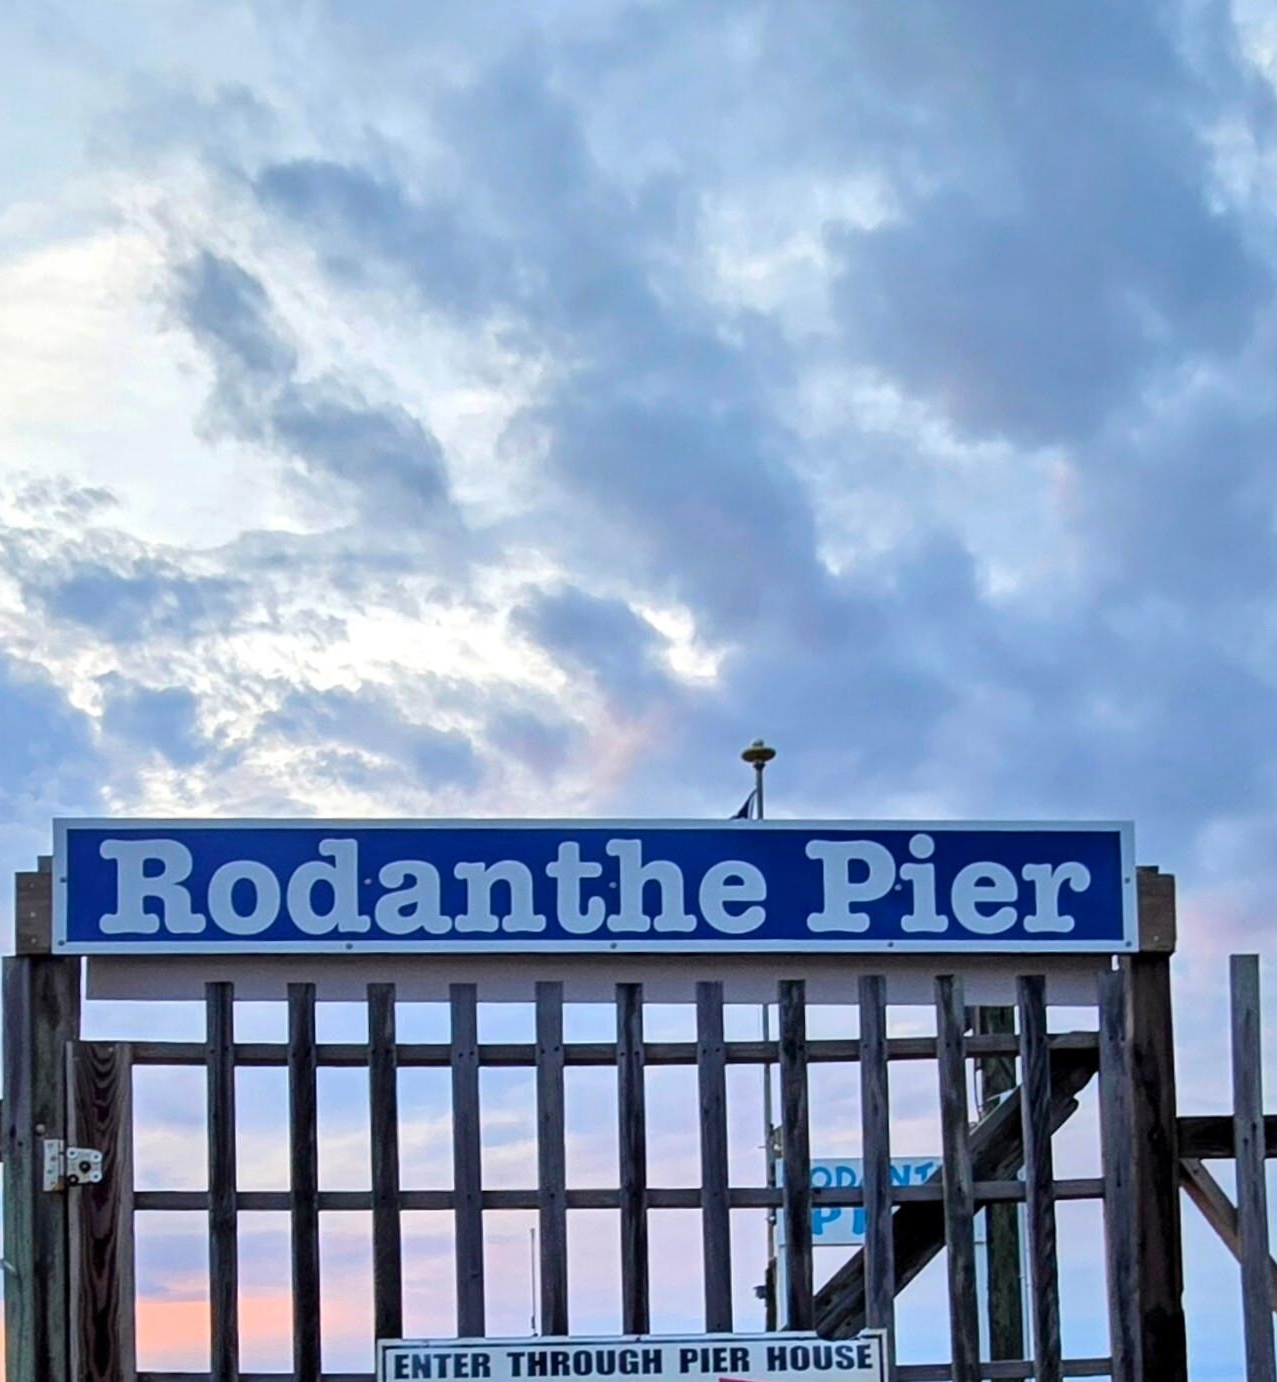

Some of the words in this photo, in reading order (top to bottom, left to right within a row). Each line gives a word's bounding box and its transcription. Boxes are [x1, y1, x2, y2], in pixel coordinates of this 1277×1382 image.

[97, 836, 768, 936] Rodanthe
[804, 832, 1093, 935] Pier
[393, 1351, 492, 1380] ENTER
[506, 1348, 663, 1378] THROUGH
[678, 1345, 751, 1374] PIER
[765, 1343, 874, 1372] HOUSE
